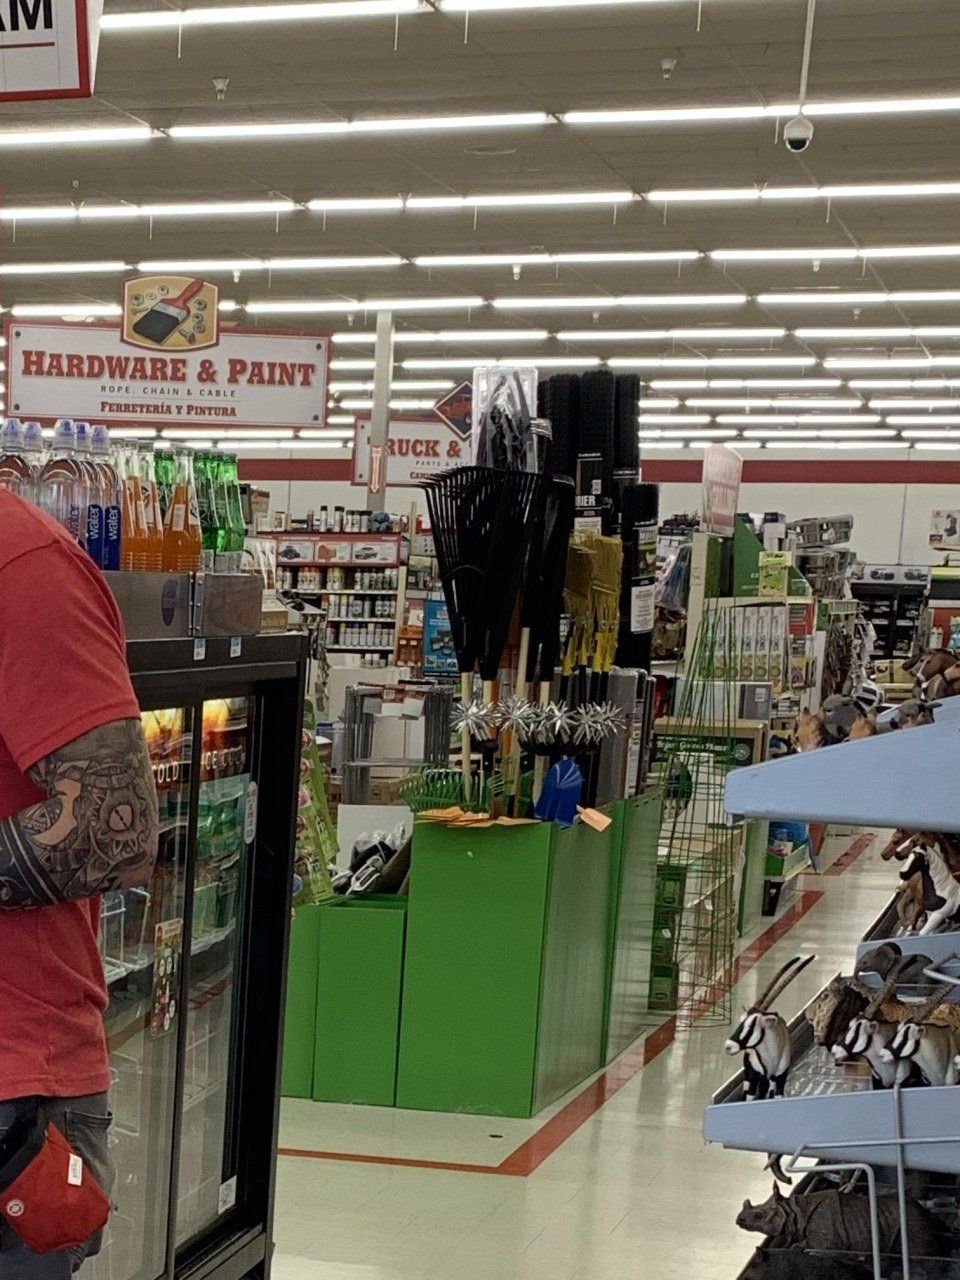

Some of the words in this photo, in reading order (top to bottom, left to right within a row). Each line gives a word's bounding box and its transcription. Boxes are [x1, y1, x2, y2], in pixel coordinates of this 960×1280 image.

[21, 350, 187, 382] HARDWARE
[197, 359, 217, 383] &
[226, 358, 315, 387] PAINT
[142, 387, 180, 396] CHAIN
[186, 388, 193, 396] &
[199, 389, 237, 398] CABLE
[100, 401, 172, 415] FERRETERÍA
[175, 405, 183, 415] Y
[186, 405, 237, 417] PINTURA
[367, 436, 440, 458] RUCK
[446, 440, 462, 458] &
[90, 506, 100, 540] water
[108, 507, 119, 541] water
